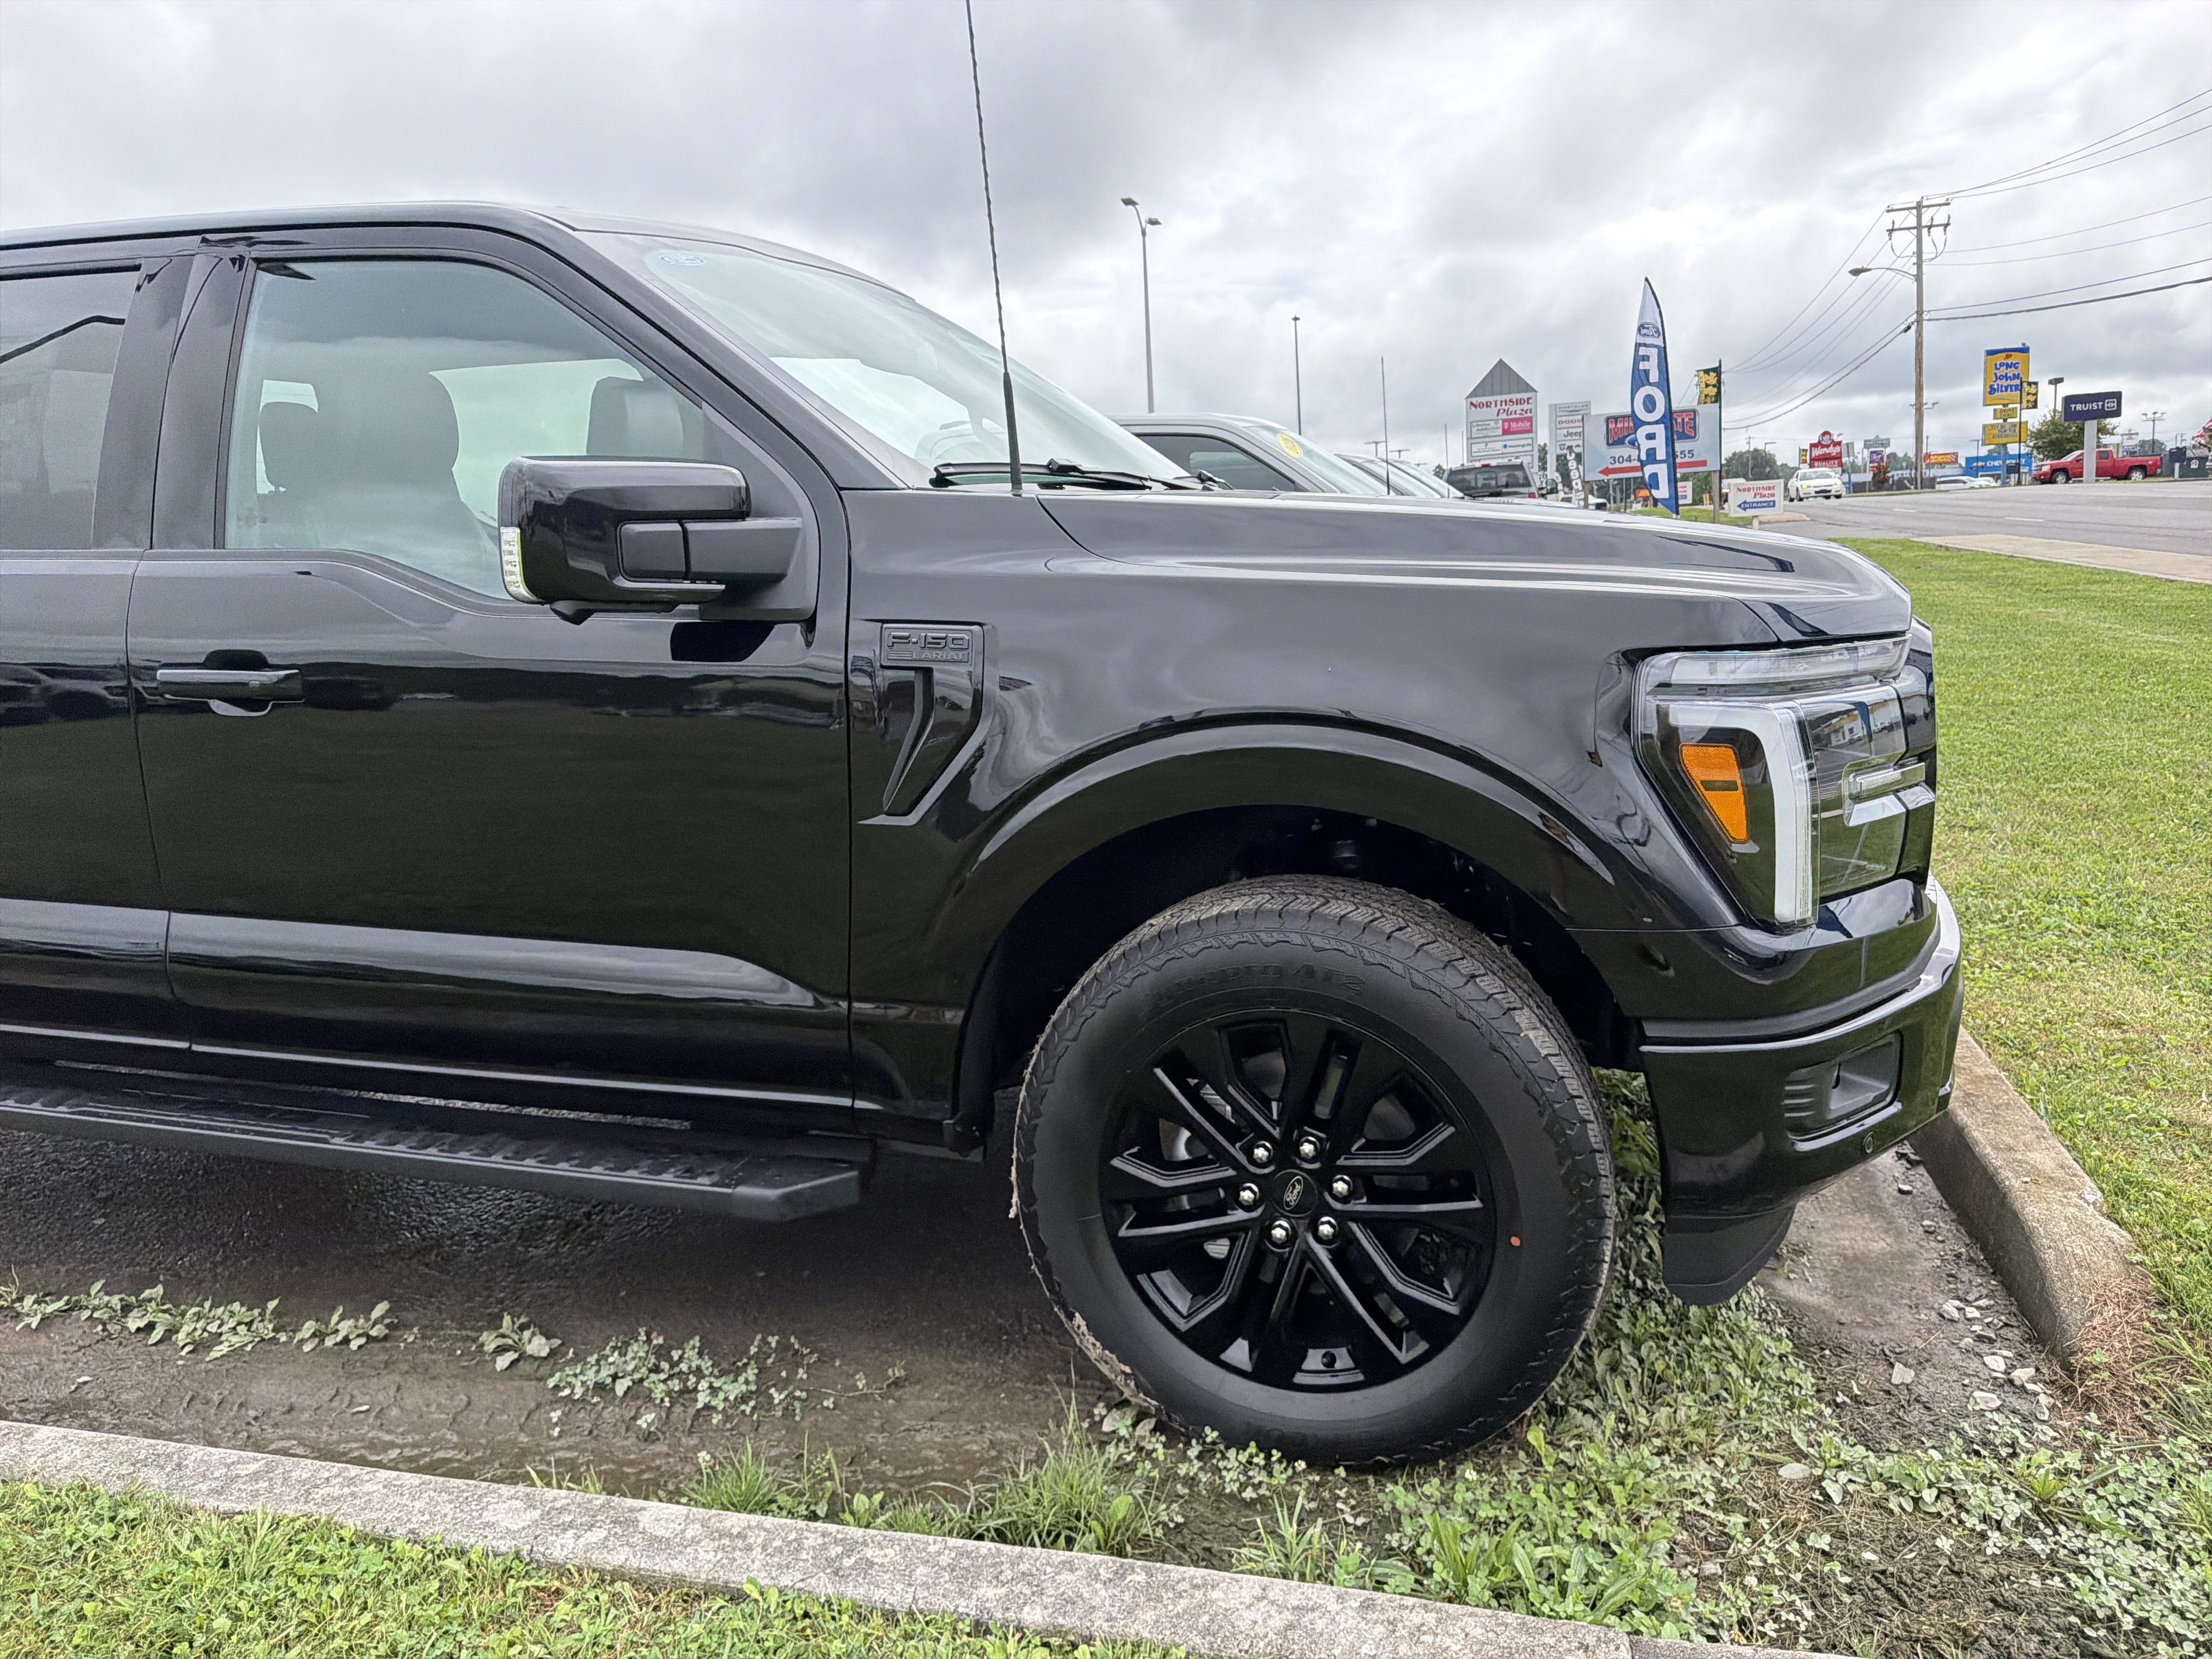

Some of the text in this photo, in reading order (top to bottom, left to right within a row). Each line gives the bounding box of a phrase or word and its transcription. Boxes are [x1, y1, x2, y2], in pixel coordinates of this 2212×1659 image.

[1994, 361, 2020, 371] LONG
[1988, 383, 2021, 396] SILVER
[1470, 397, 1532, 410] NORTHSIDE
[2070, 402, 2103, 411] TRUIST
[1496, 407, 1532, 417] Plaza
[887, 632, 969, 650] F-150
[912, 651, 965, 661] LARIAT
[1285, 1181, 1301, 1206] Ford
